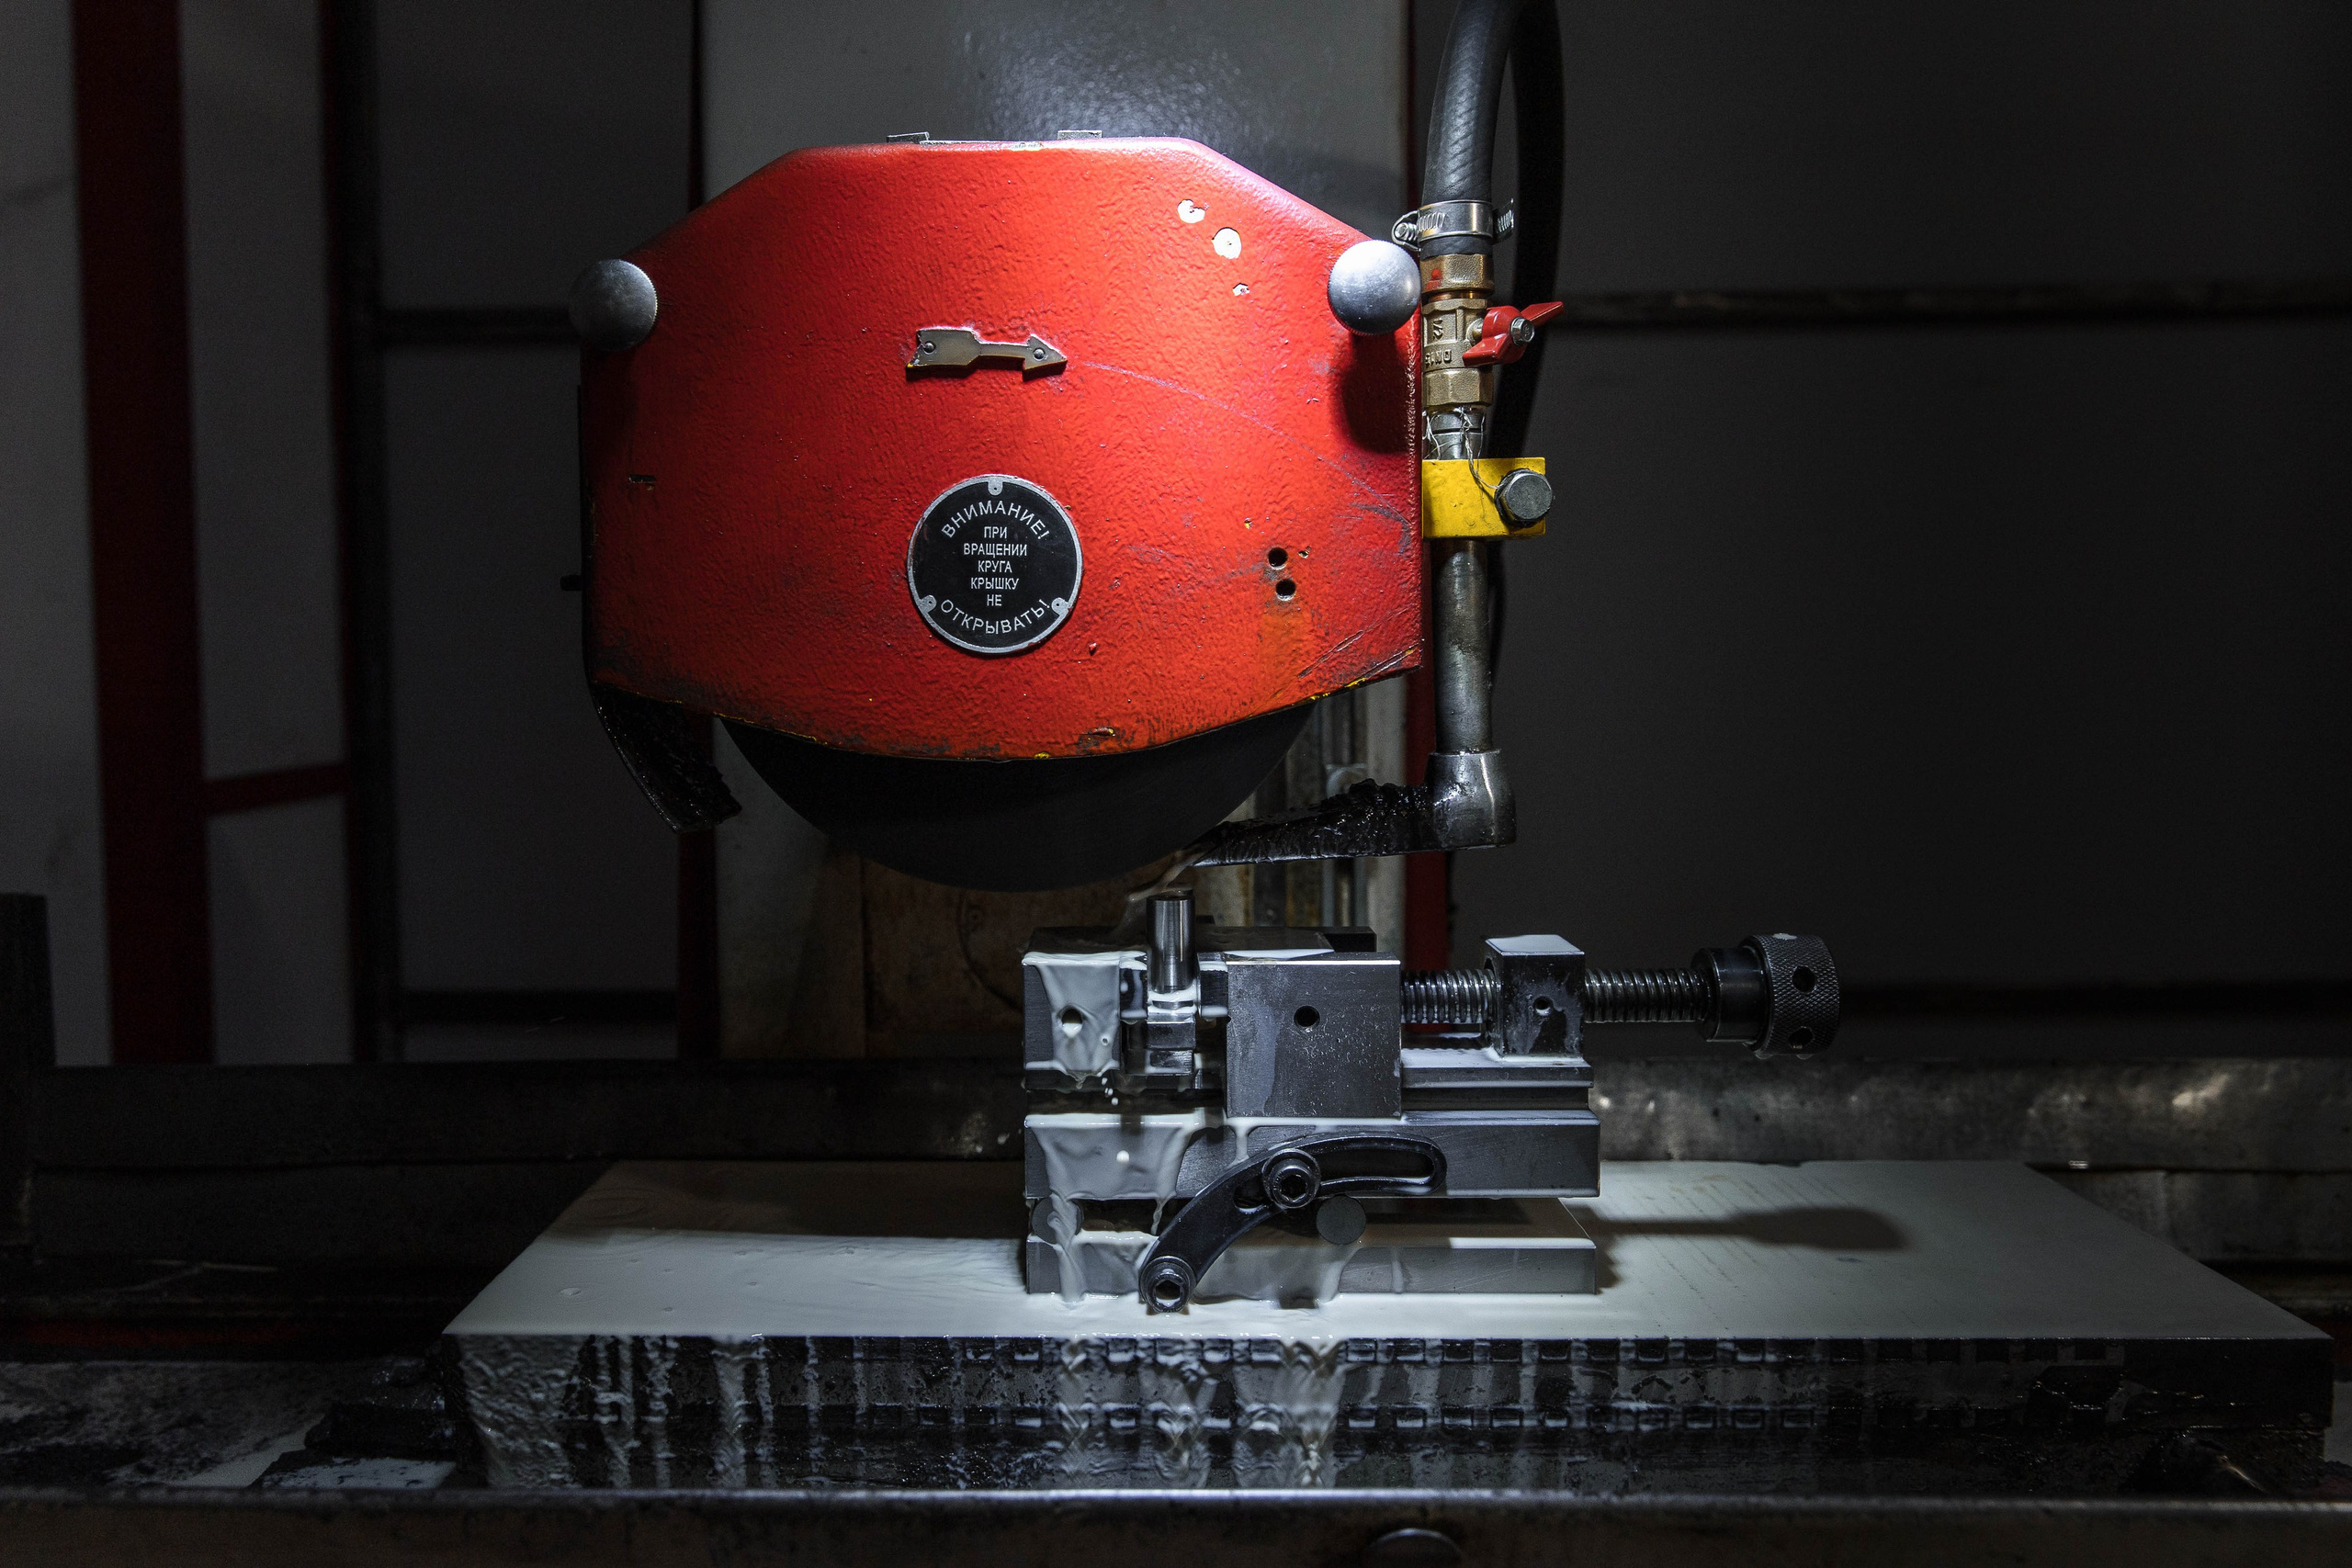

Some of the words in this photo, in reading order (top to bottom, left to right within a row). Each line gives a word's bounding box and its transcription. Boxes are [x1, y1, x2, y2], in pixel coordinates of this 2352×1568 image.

[941, 500, 1050, 540] ВНИМАНИЕ!
[983, 526, 1008, 539] ПРИ
[963, 543, 1027, 558] ВРАЩЕНИИ
[978, 560, 1012, 573] КРУГА
[970, 577, 1020, 590] КРЫШКУ
[987, 594, 1002, 606] НЕ
[940, 599, 1050, 635] ОТКРЫВАТЬ!
